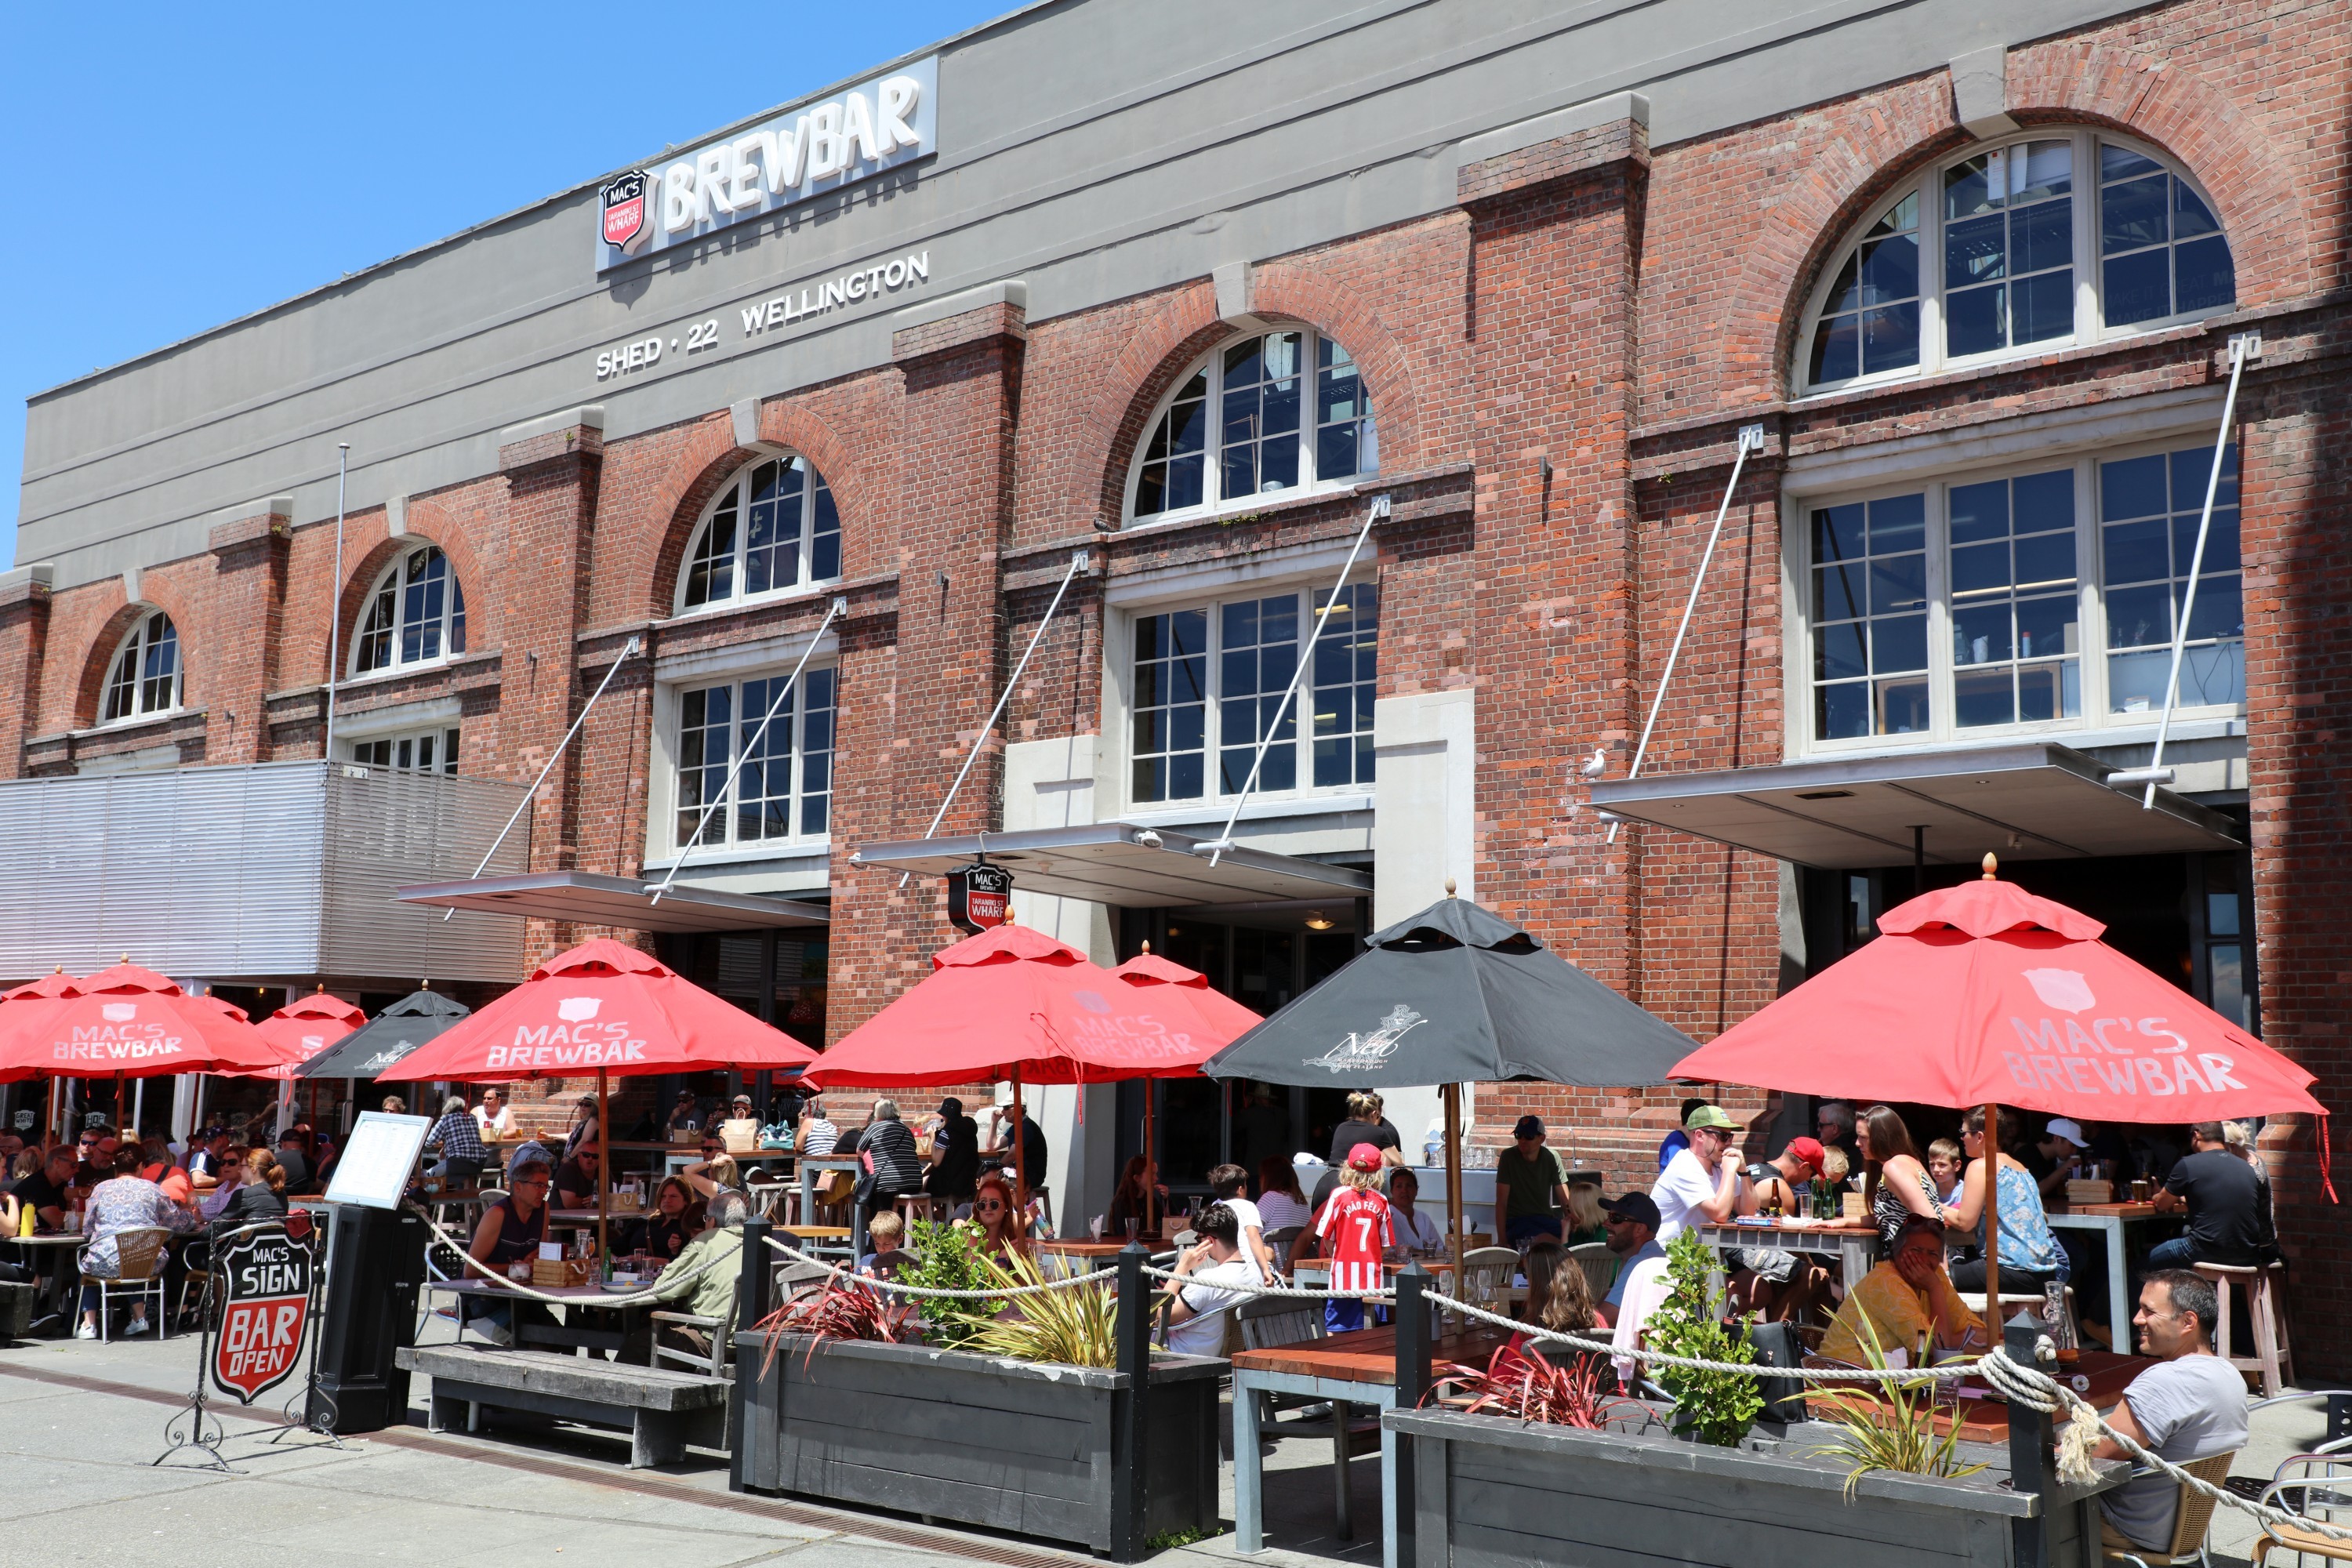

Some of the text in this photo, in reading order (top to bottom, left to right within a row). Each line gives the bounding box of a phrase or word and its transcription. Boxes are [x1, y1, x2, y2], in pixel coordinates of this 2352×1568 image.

[662, 75, 920, 234] BREWBAR
[610, 180, 640, 205] MAC'S
[632, 202, 640, 213] ST
[608, 211, 639, 234] WHARF
[596, 250, 931, 379] SHED 22 WELLINGTON
[975, 873, 1002, 887] MAC'S
[971, 905, 1004, 918] WHARF
[72, 1023, 166, 1042] MAC'S
[514, 1022, 629, 1046] MAC'S
[1072, 1014, 1167, 1037] MAC'S
[2009, 1017, 2189, 1054] MAC'S
[53, 1036, 183, 1060] BREWBAR
[485, 1040, 647, 1068] BREWBAR
[1073, 1033, 1200, 1059] BREWBAR
[2001, 1053, 2249, 1096] BREWBAR
[86, 1114, 105, 1124] HOP
[1342, 1200, 1383, 1220] JOÃO FÉLIX
[1356, 1218, 1372, 1252] 7
[252, 1247, 289, 1264] MAC'S
[226, 1305, 298, 1353] BAR
[227, 1347, 285, 1377] OPEN
